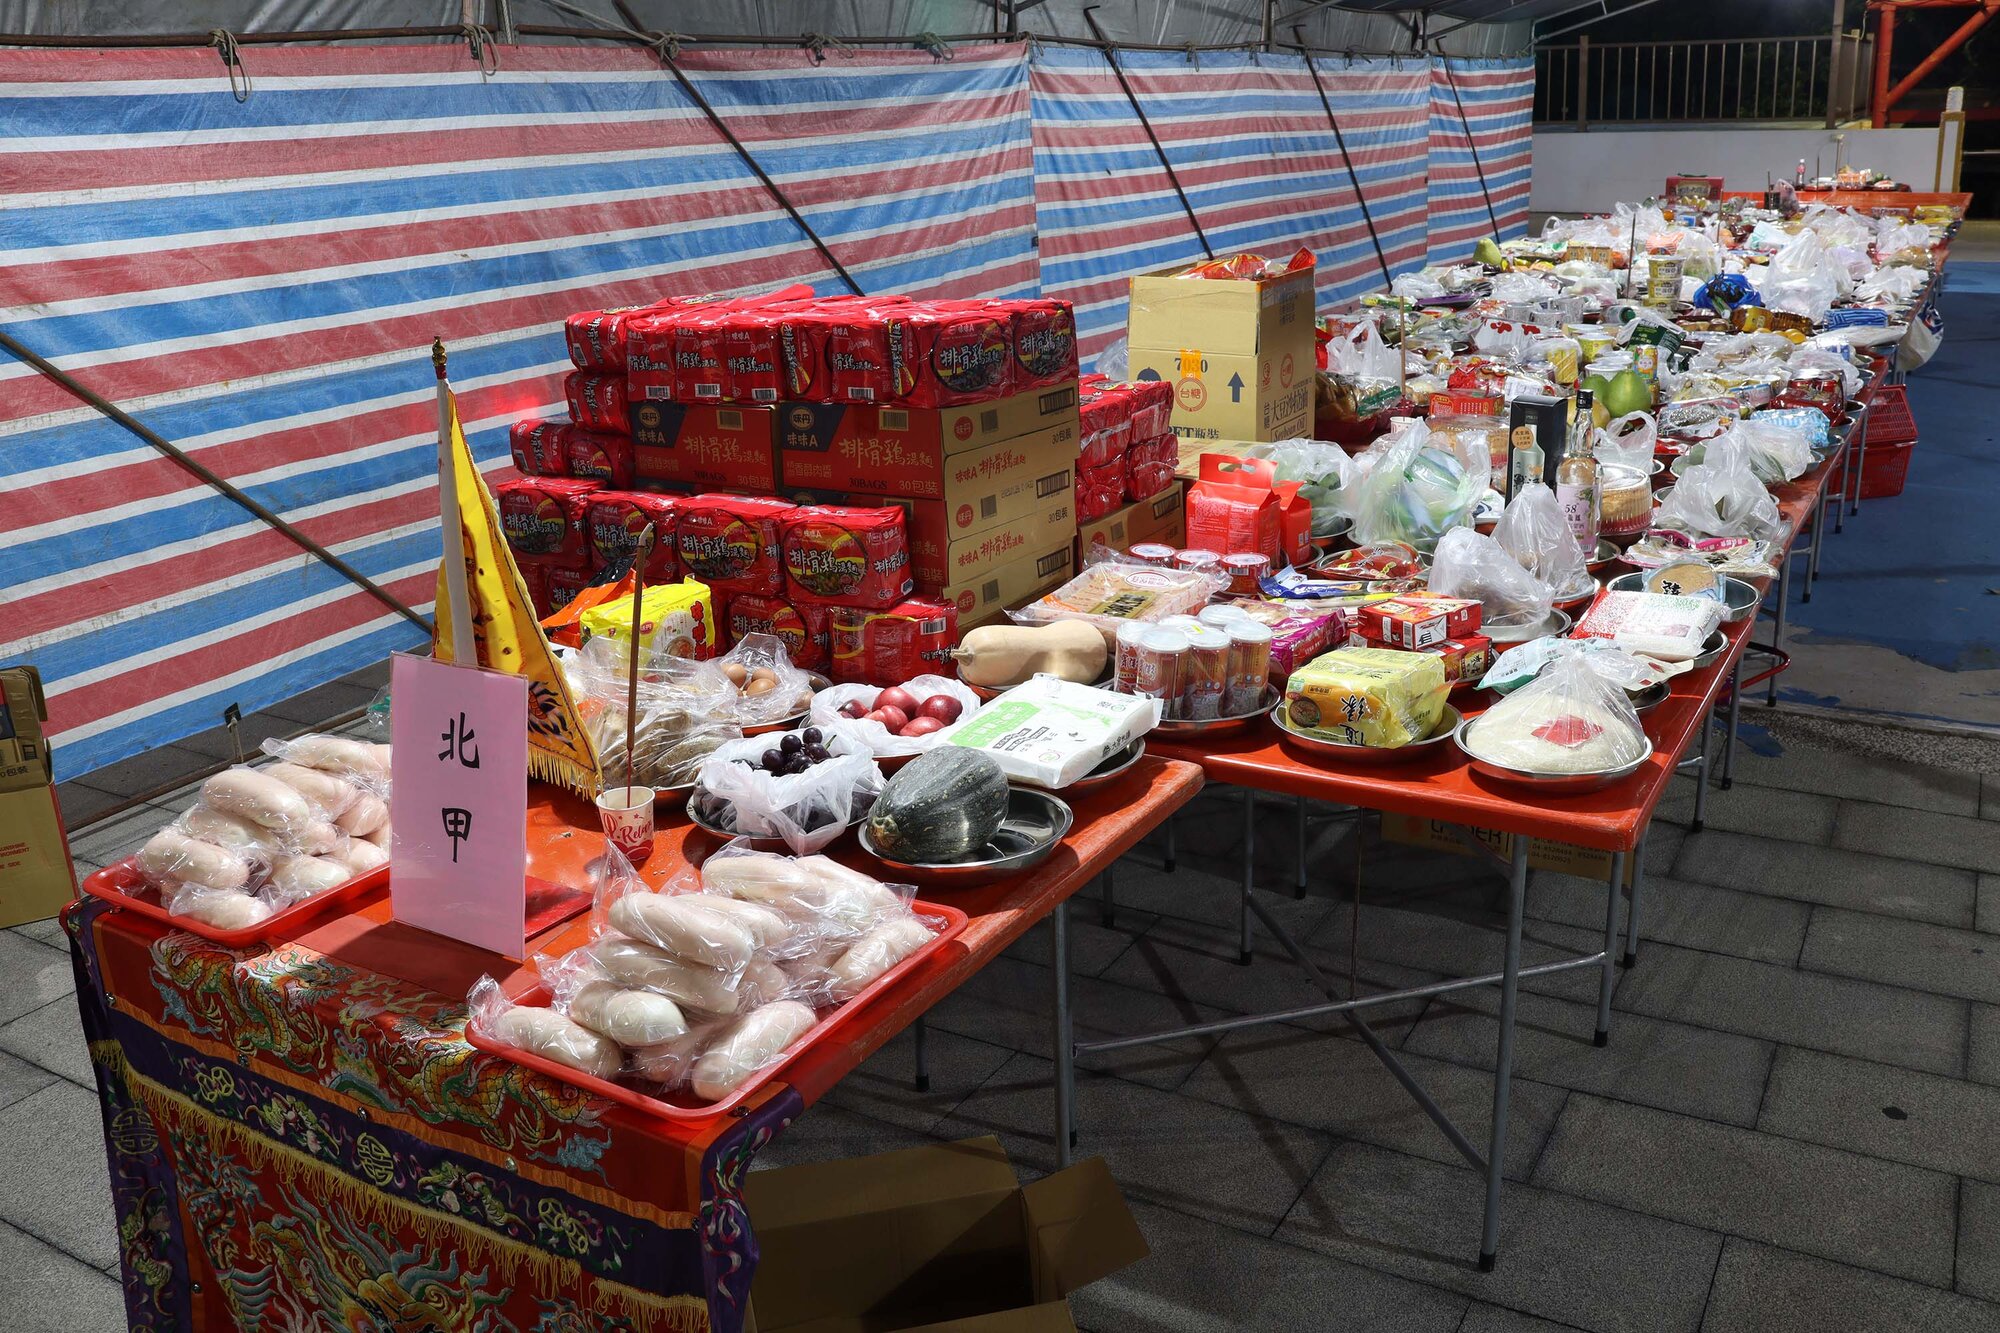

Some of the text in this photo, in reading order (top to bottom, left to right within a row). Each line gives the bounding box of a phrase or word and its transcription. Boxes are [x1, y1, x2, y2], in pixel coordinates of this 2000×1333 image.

[642, 412, 659, 423] 味丹
[793, 413, 811, 425] 味丹
[637, 429, 667, 445] 味味A
[787, 432, 819, 449] 味味A
[736, 475, 773, 490] 30包裝
[850, 476, 888, 491] 30BAGS
[899, 479, 939, 495] 30包裝
[437, 711, 480, 864] 北甲
